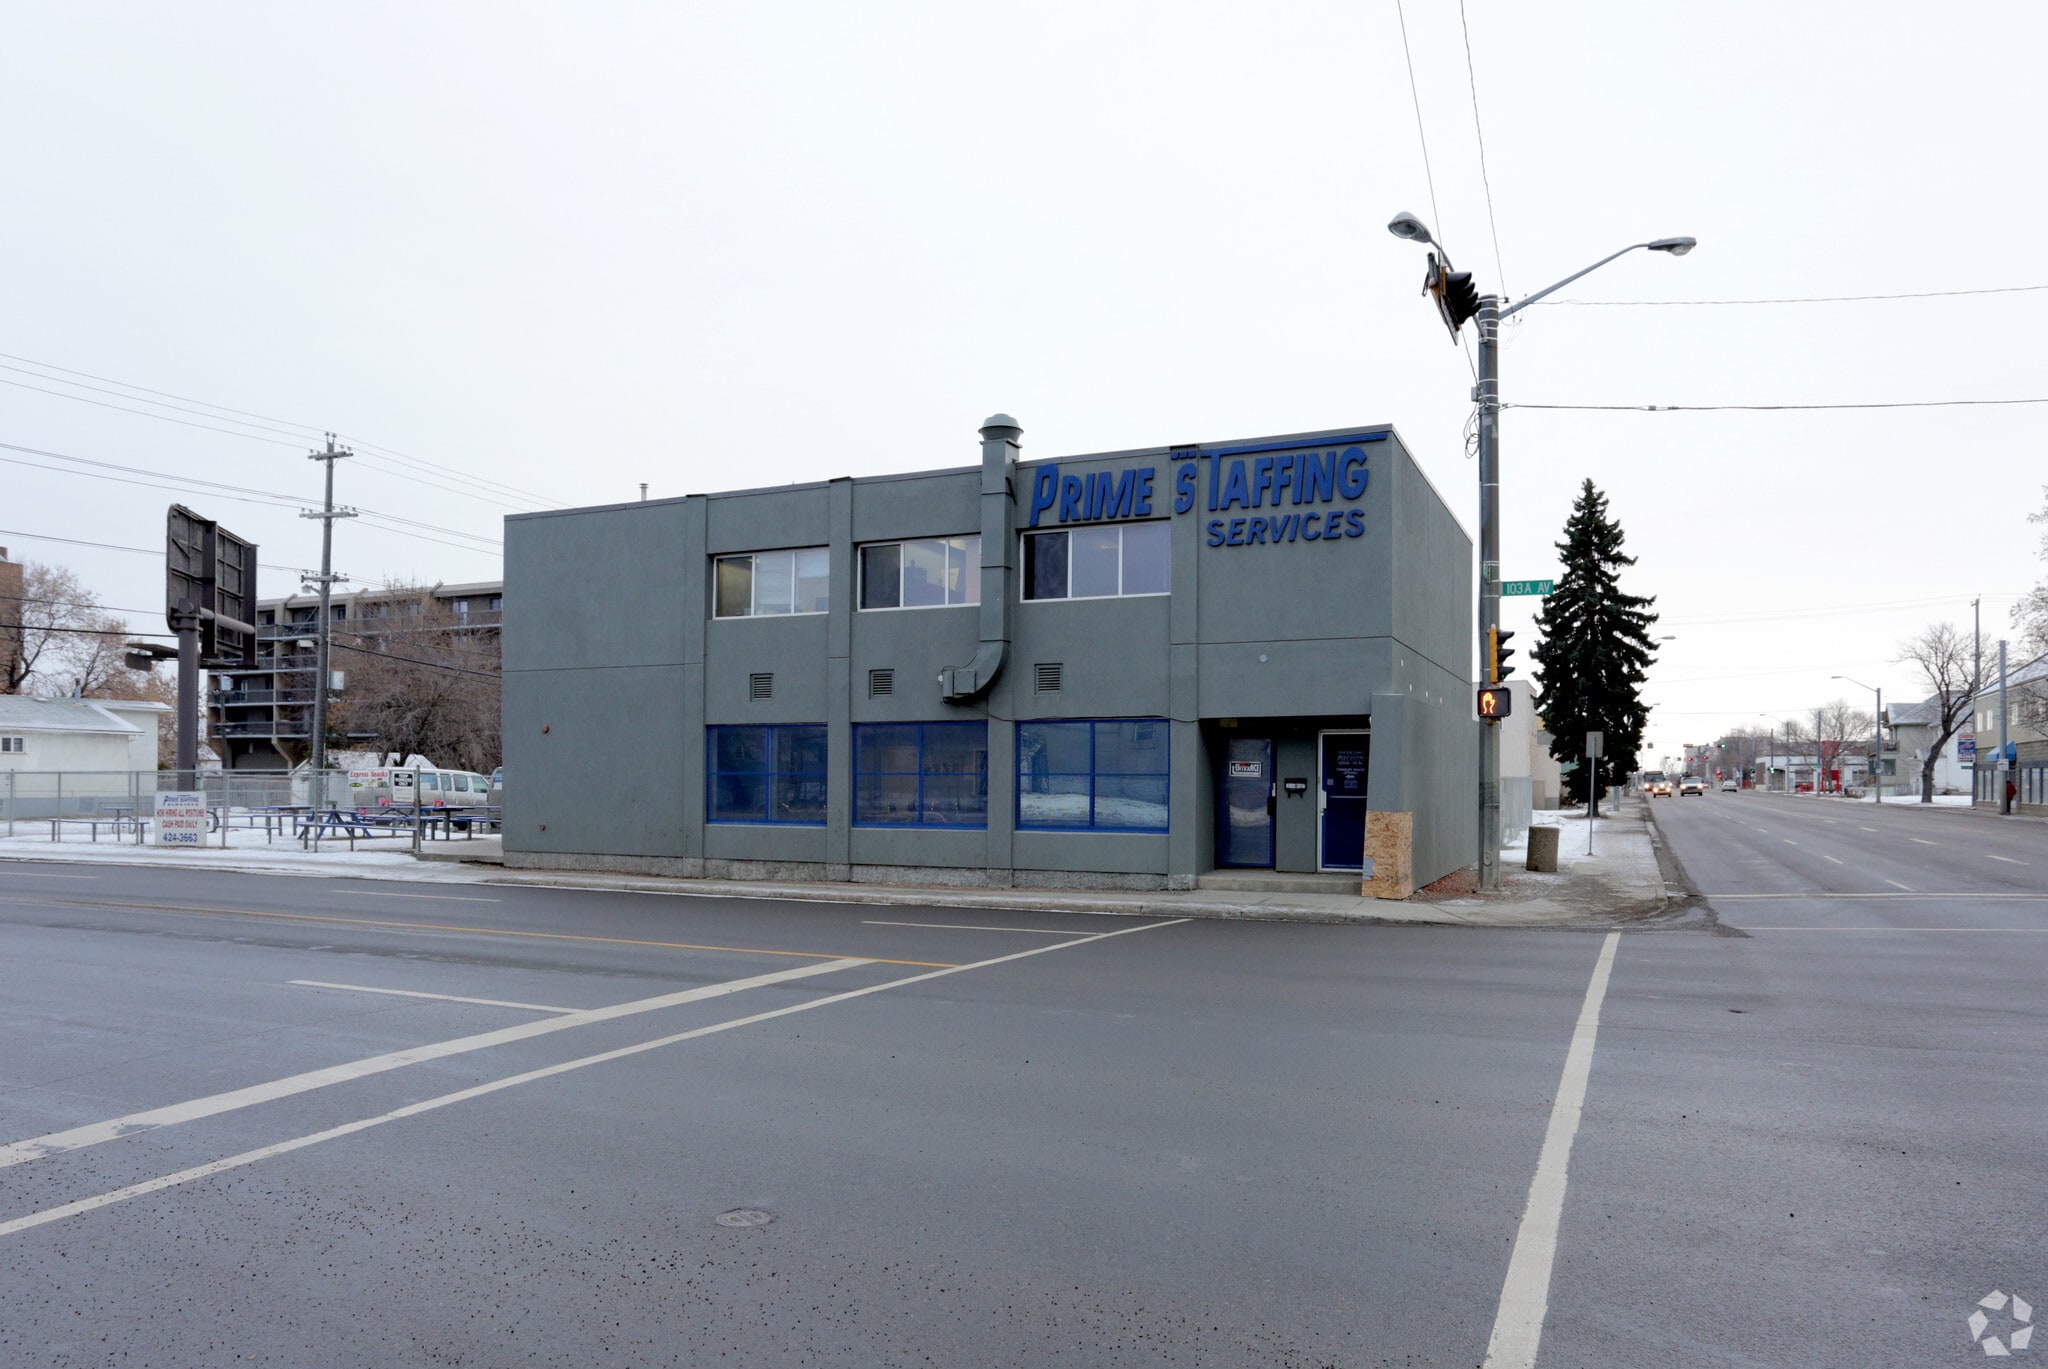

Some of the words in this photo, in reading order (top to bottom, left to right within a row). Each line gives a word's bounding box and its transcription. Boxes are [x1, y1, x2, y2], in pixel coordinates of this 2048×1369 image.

[1029, 463, 1155, 527] PRIME
[1207, 508, 1366, 547] SERVICES
[1506, 583, 1532, 595] 103A
[1537, 581, 1551, 593] AV
[163, 833, 198, 842] 424-3663
